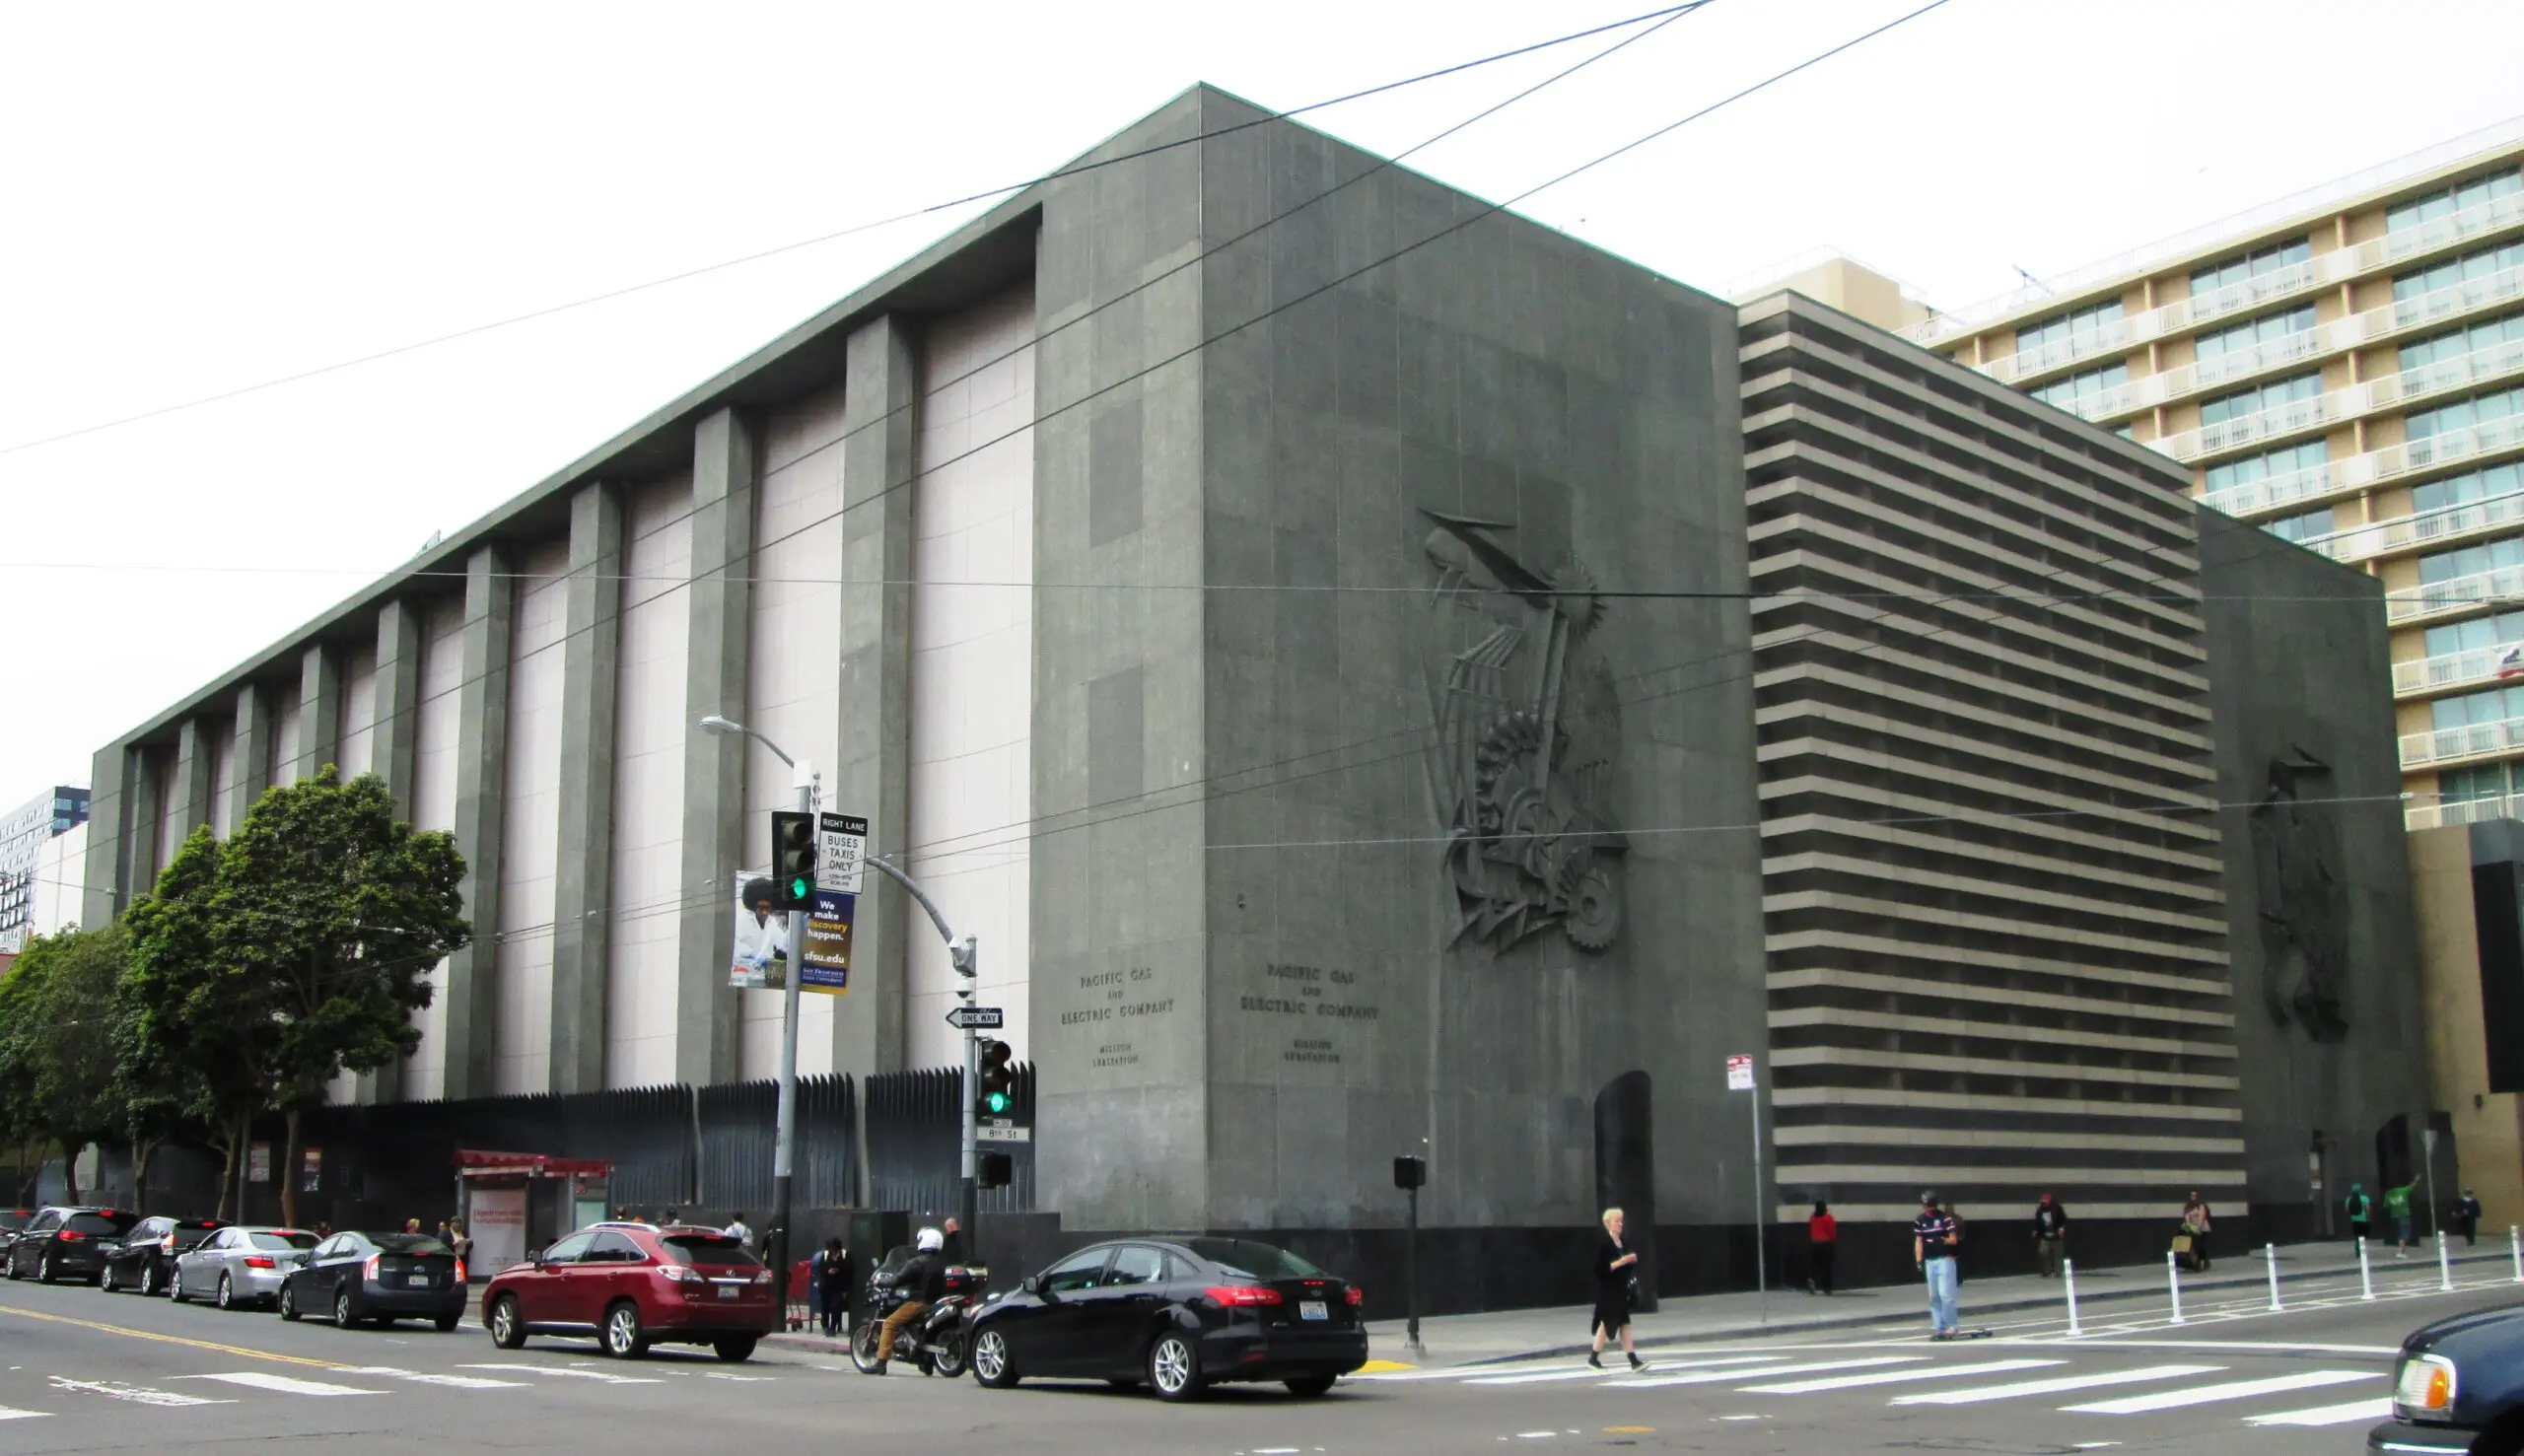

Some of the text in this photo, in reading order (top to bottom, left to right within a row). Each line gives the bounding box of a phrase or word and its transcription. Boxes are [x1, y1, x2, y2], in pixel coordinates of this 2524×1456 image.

[822, 818, 866, 832] RIGHT LANE
[828, 835, 859, 849] BUSES
[830, 848, 855, 861] TAXIS
[829, 860, 853, 872] ONLY
[819, 900, 835, 911] We
[814, 911, 840, 921] make
[807, 928, 844, 941] happen.
[804, 951, 845, 964] sfsu.edu
[1081, 967, 1153, 989] PACIFIC GAS
[1267, 963, 1321, 981] PACIFIC
[1107, 990, 1125, 1002] AND
[1061, 999, 1175, 1025] ELECTRIC COMPANY
[1240, 996, 1379, 1019] ELECTRIC COMPANY
[961, 1013, 997, 1023] ONE WAY
[989, 1129, 1017, 1140] 8th St
